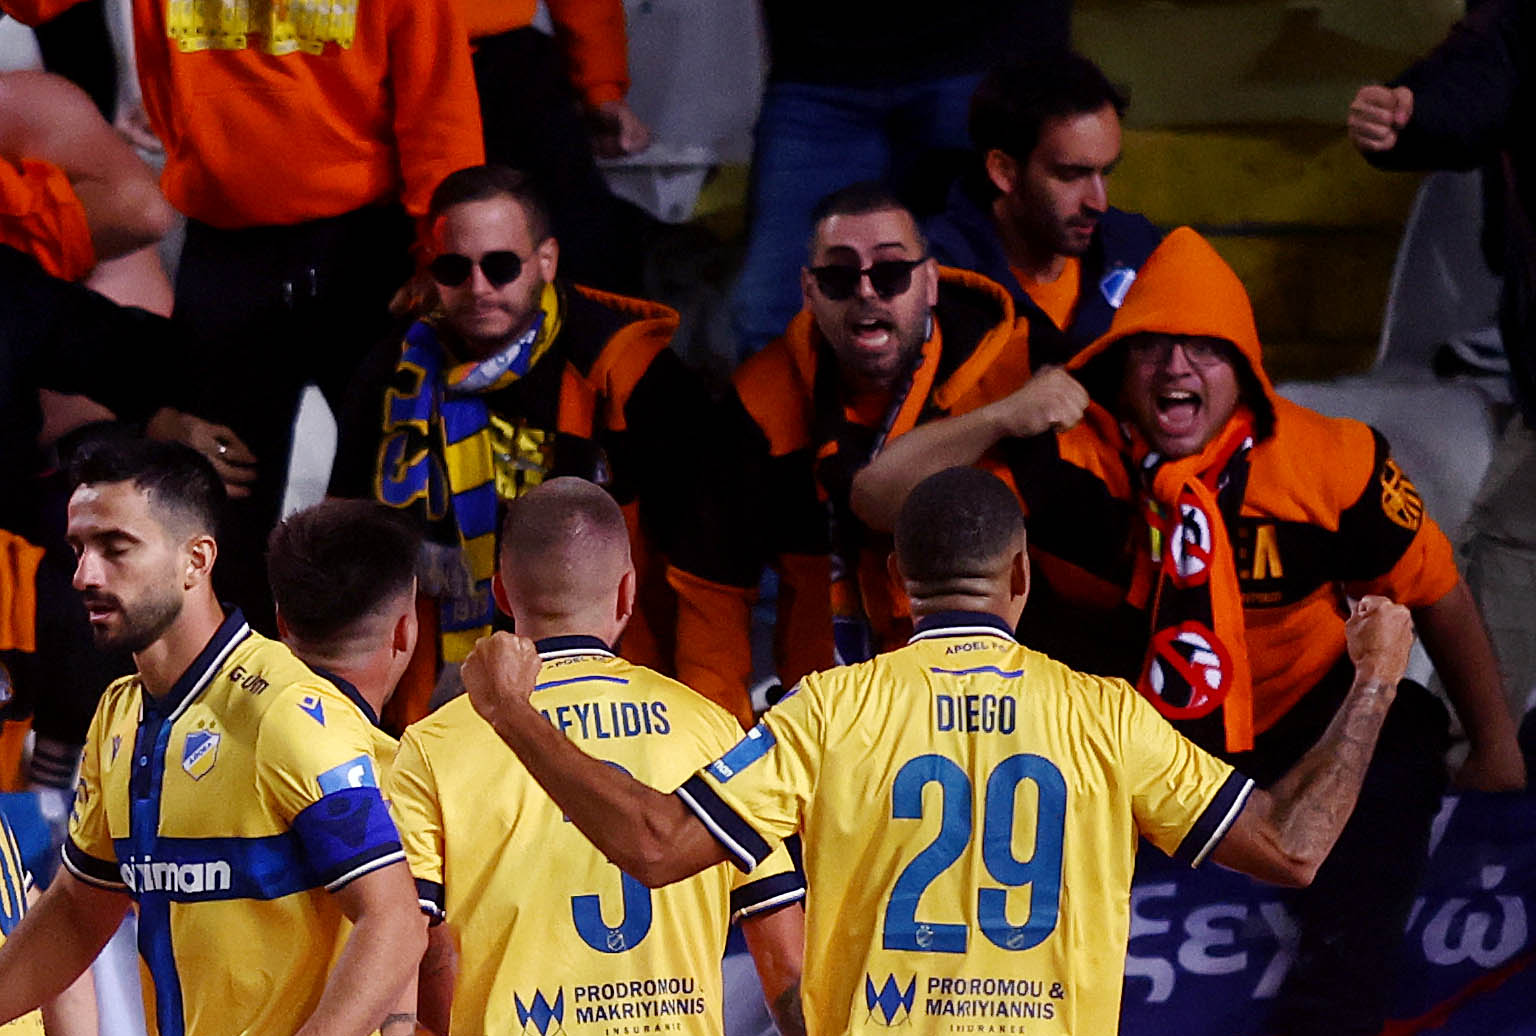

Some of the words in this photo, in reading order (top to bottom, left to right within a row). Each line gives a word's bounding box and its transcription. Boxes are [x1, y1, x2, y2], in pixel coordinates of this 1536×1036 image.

[945, 641, 988, 654] APOEL
[936, 694, 1016, 735] DIEGO
[882, 753, 1068, 954] 29
[1048, 981, 1064, 1000] &
